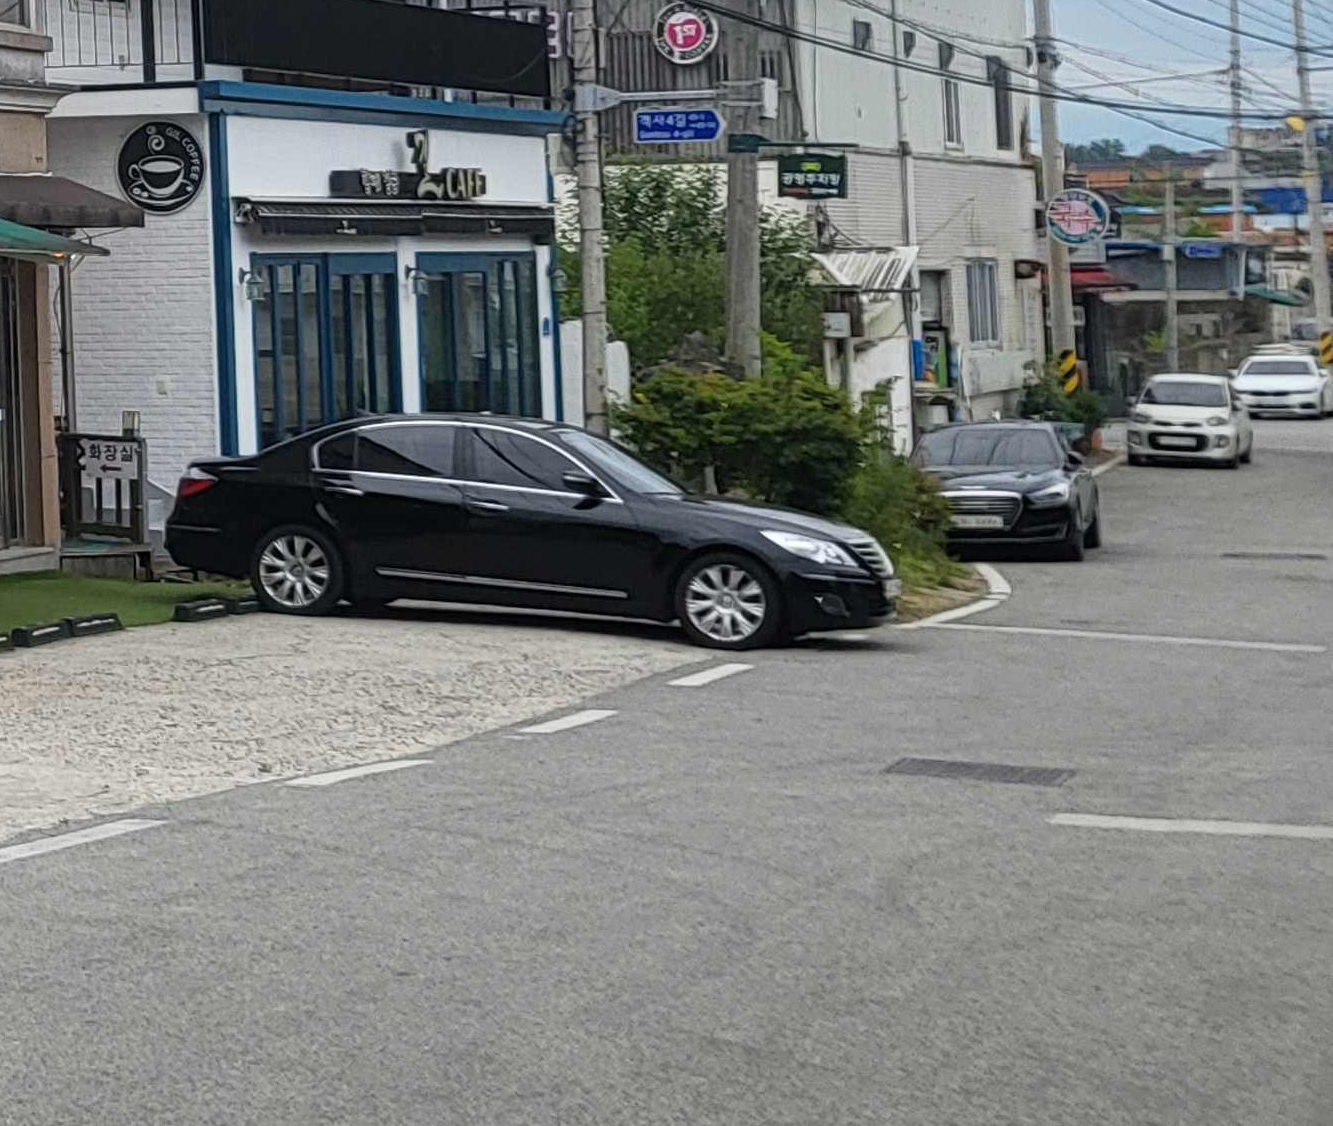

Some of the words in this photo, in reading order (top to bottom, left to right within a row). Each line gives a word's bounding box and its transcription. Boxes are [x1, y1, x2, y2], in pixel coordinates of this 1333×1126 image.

[181, 138, 200, 181] COFFEE
[446, 167, 484, 199] CAFE
[88, 443, 133, 462] 화장실
